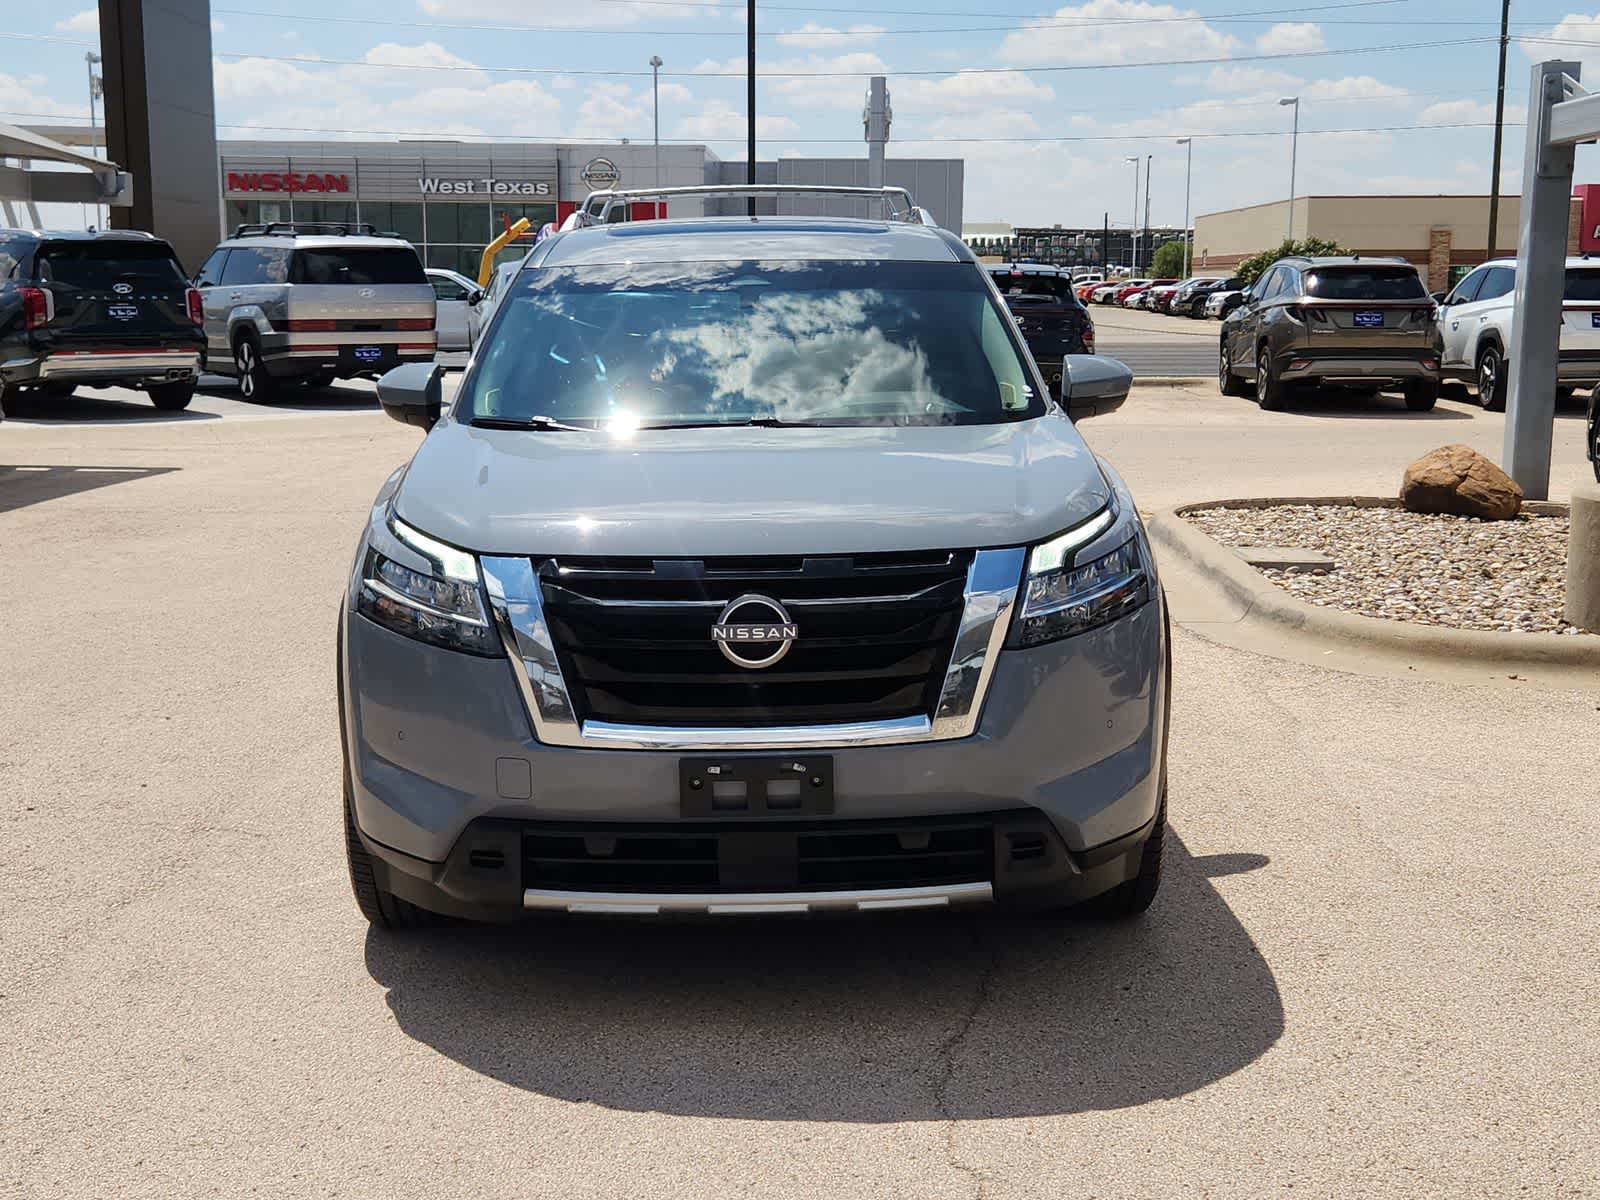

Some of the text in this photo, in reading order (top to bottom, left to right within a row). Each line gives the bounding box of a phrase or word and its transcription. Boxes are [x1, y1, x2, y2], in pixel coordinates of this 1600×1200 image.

[227, 172, 349, 193] NISSAN
[418, 178, 550, 195] West Texas
[713, 626, 796, 639] NISSAN
